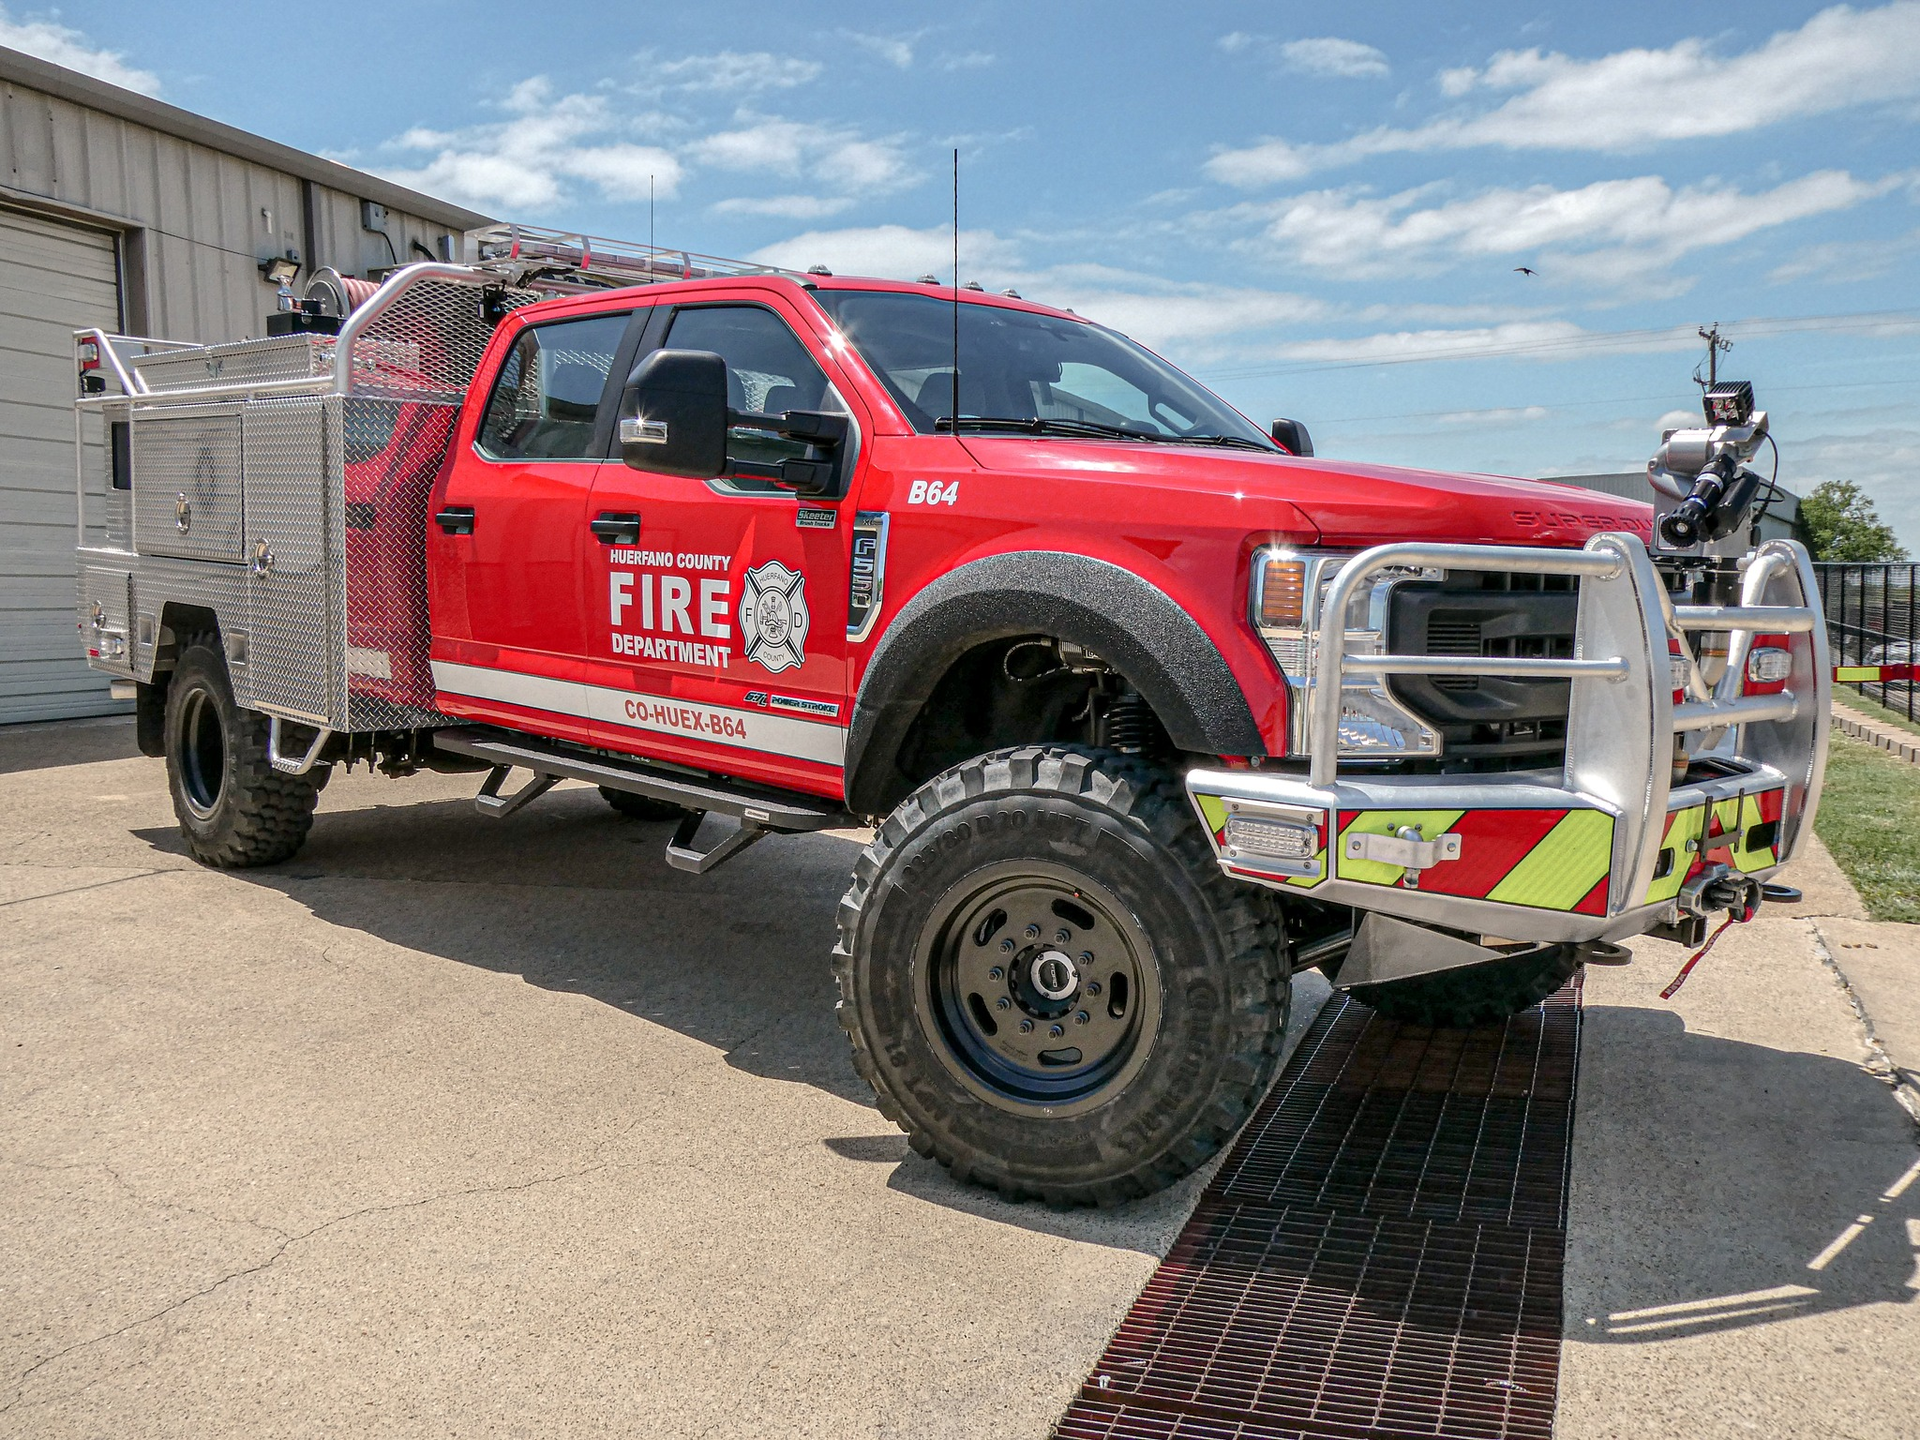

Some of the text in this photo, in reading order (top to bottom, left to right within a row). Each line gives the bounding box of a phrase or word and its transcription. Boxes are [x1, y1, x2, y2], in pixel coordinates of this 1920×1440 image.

[907, 480, 960, 506] B64
[797, 510, 834, 521] Skeeter
[1510, 510, 1653, 533] SUPER DU
[609, 548, 732, 572] HUERFANO COUNTY
[758, 572, 789, 586] HUERFANO
[609, 571, 732, 639] FIRE
[745, 607, 803, 629] F D
[611, 632, 732, 669] DEPARTMENT
[762, 651, 786, 662] COUNTY
[771, 696, 800, 708] POWER
[801, 701, 836, 713] STROKE
[623, 698, 748, 740] CO-HUEX-B64
[1049, 962, 1059, 989] FORD
[1664, 973, 1687, 995] WARN
